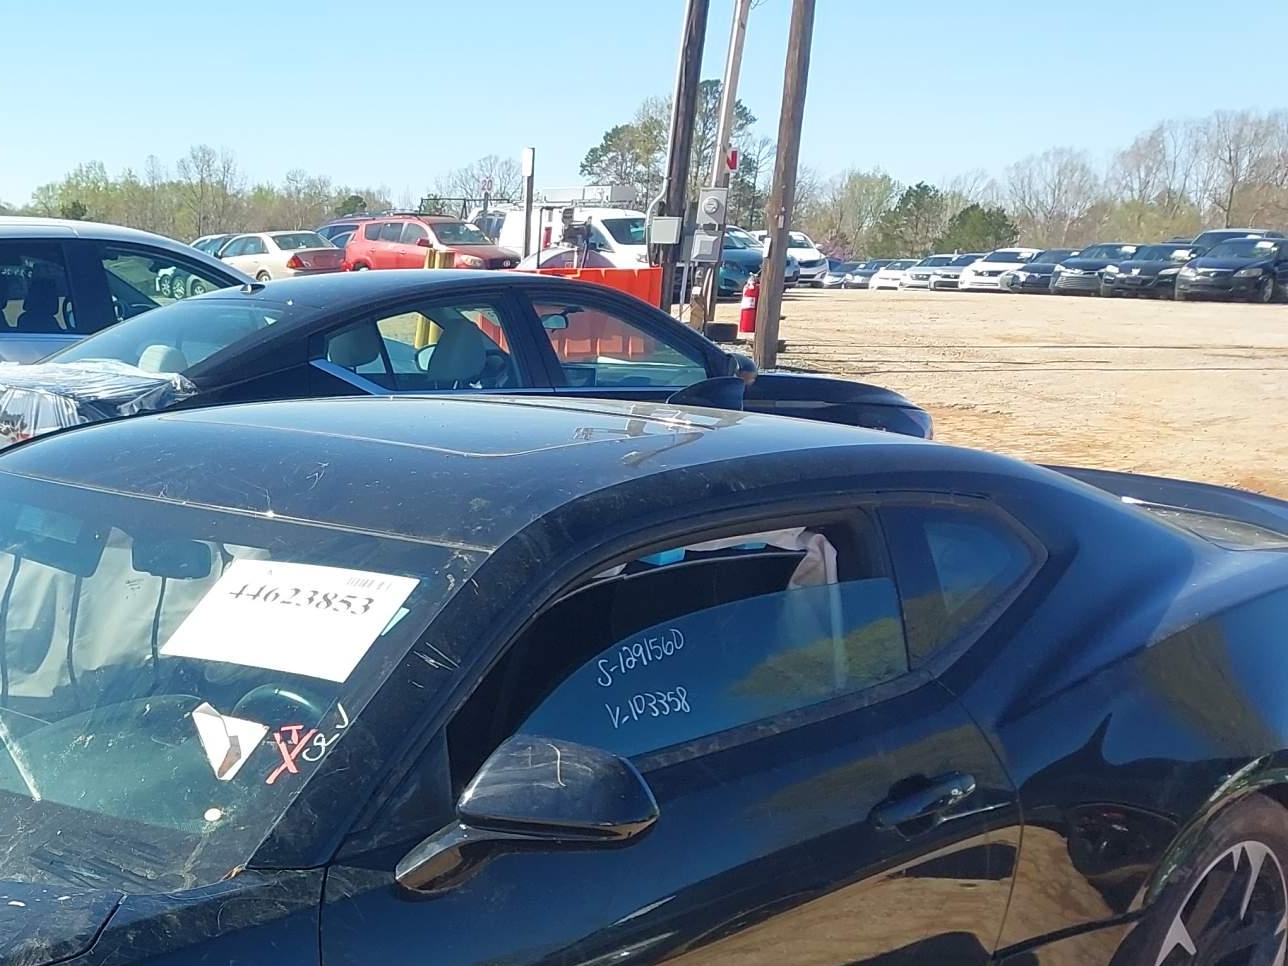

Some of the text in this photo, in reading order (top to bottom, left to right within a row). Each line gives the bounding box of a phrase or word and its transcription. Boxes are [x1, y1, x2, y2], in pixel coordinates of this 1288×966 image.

[481, 179, 493, 191] 20
[228, 584, 374, 615] 44623853
[605, 686, 691, 729] V-103358
